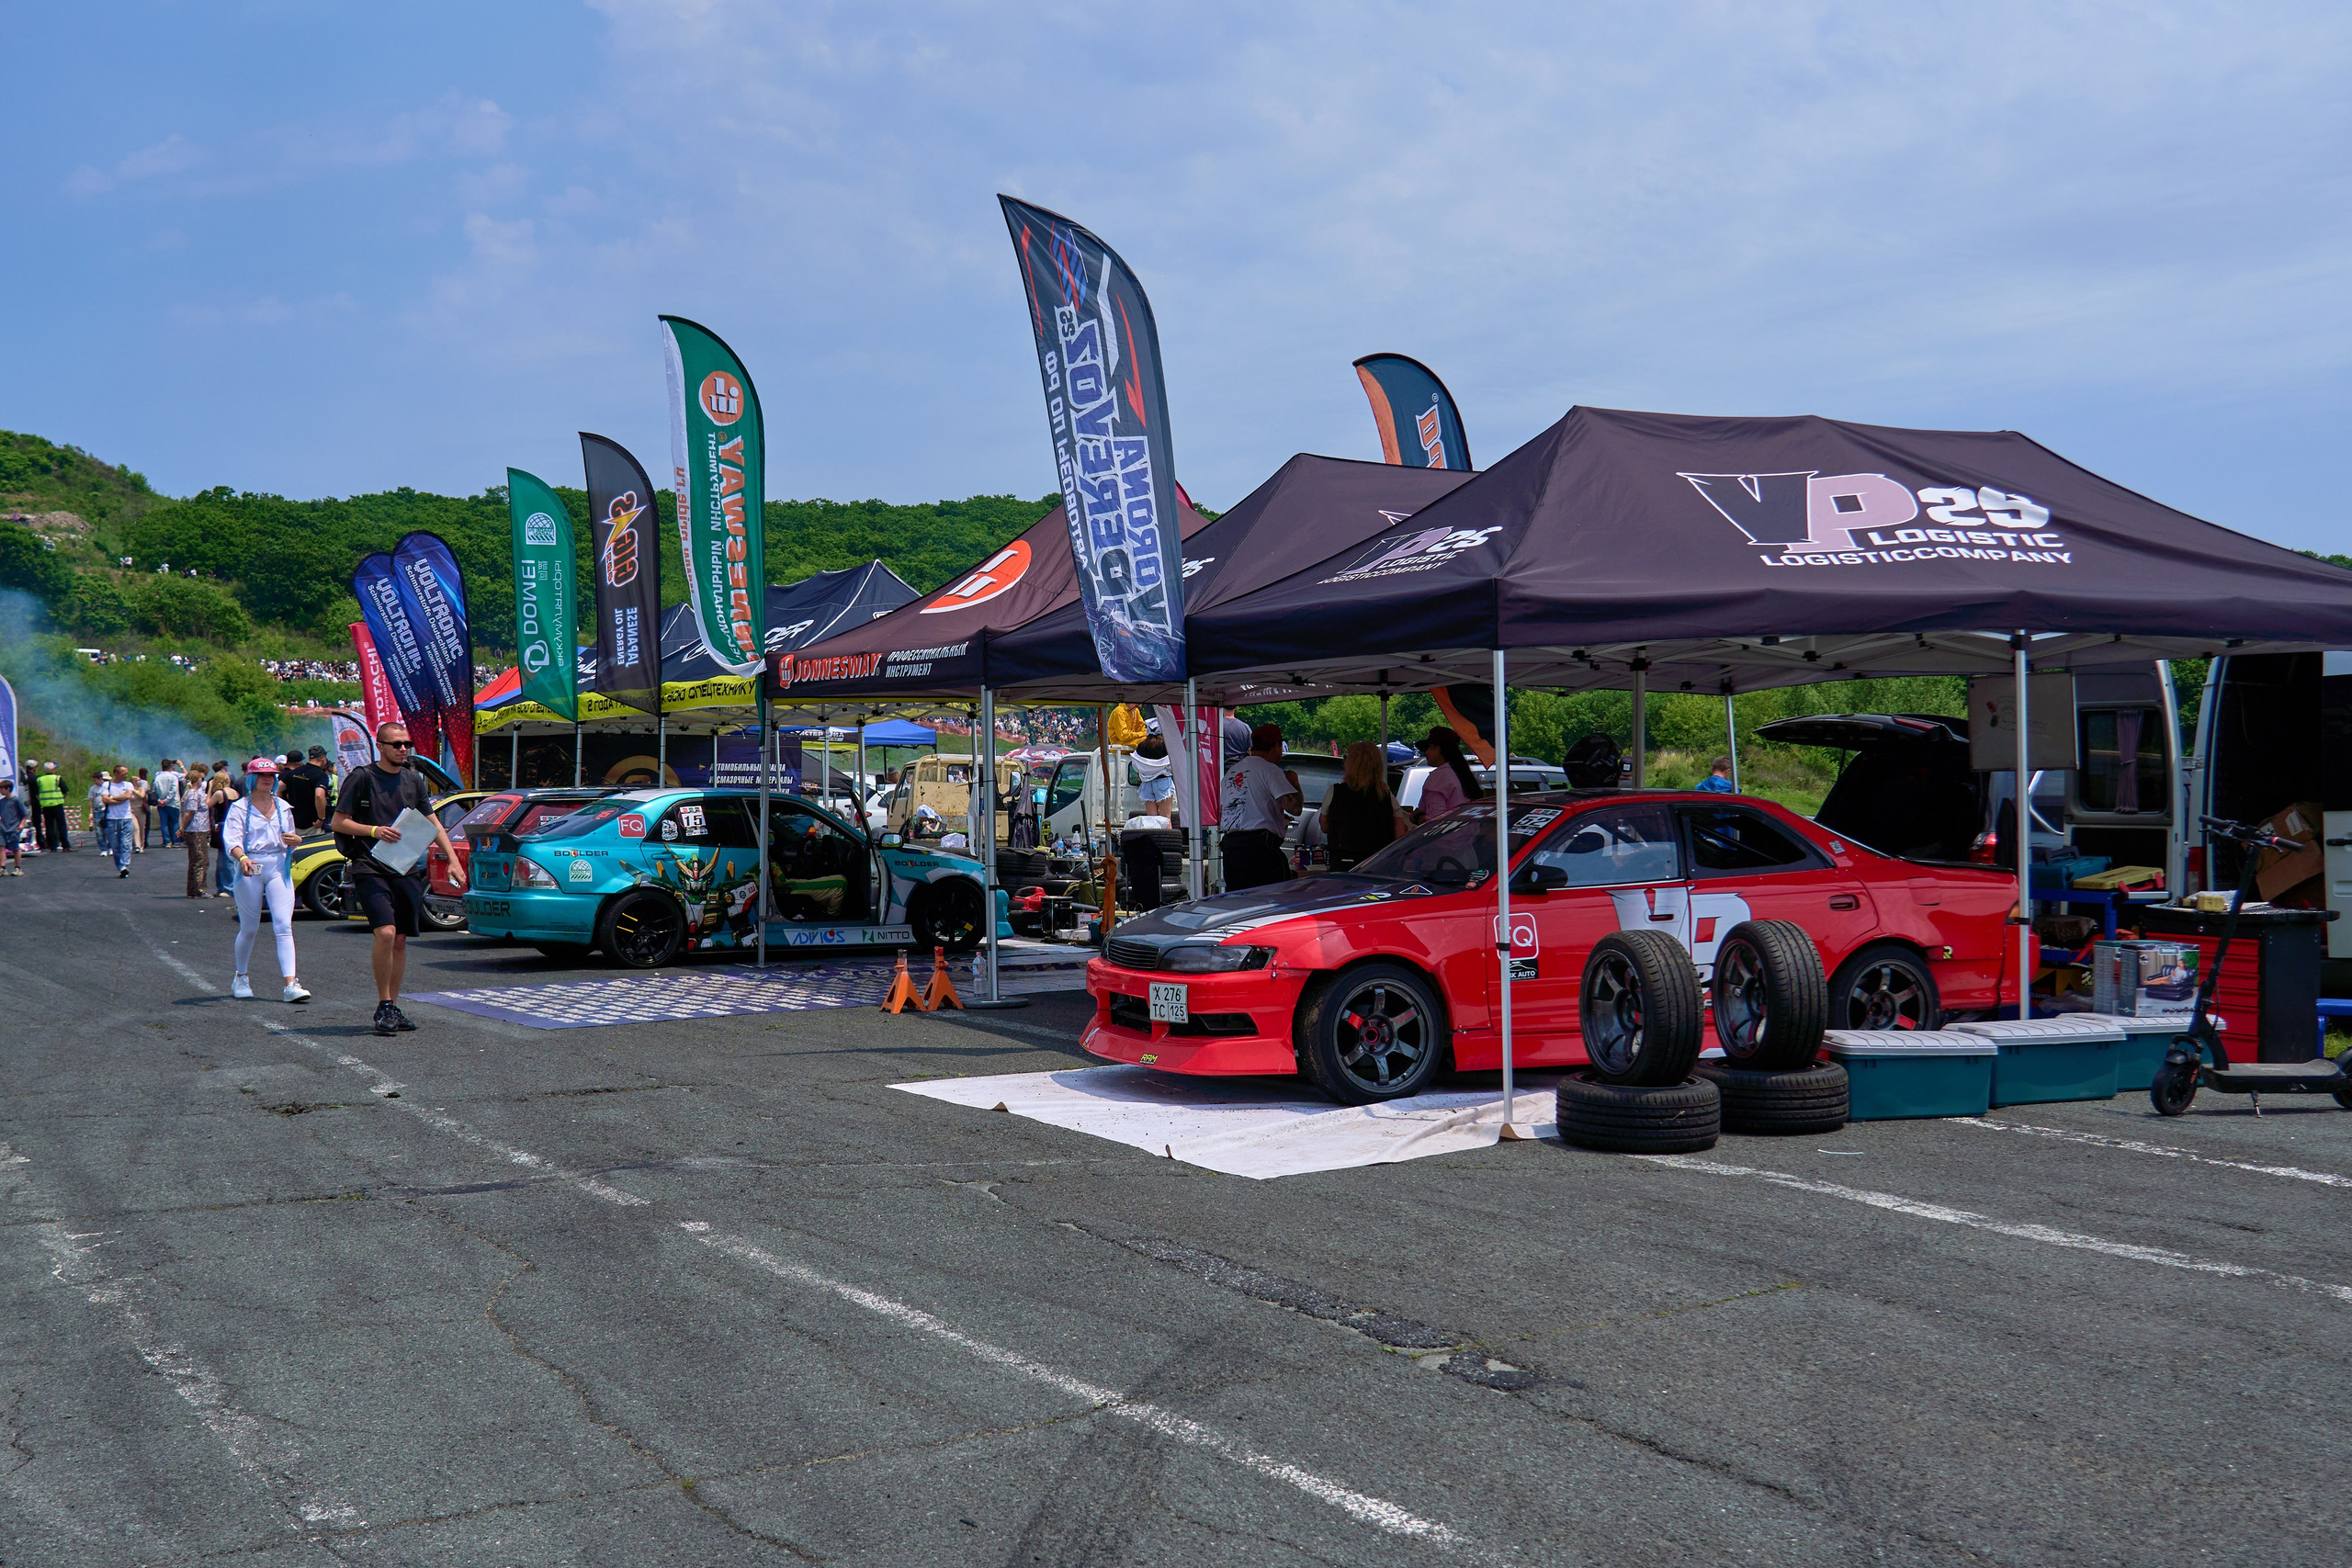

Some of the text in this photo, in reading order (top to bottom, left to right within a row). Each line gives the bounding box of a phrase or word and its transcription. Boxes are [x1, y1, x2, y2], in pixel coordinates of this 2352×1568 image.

[1868, 528, 2064, 548] LOGISTIC
[1760, 545, 2073, 568] LOGISTICCOMPANY
[428, 616, 452, 664] Deutschland
[794, 653, 883, 682] JONNESWAY
[367, 647, 387, 721] TOTACHI
[620, 819, 643, 831] FQ
[684, 814, 703, 827] 15
[877, 931, 910, 940] NITTO
[1164, 987, 1182, 1002] 276
[1170, 1006, 1184, 1017] 125
